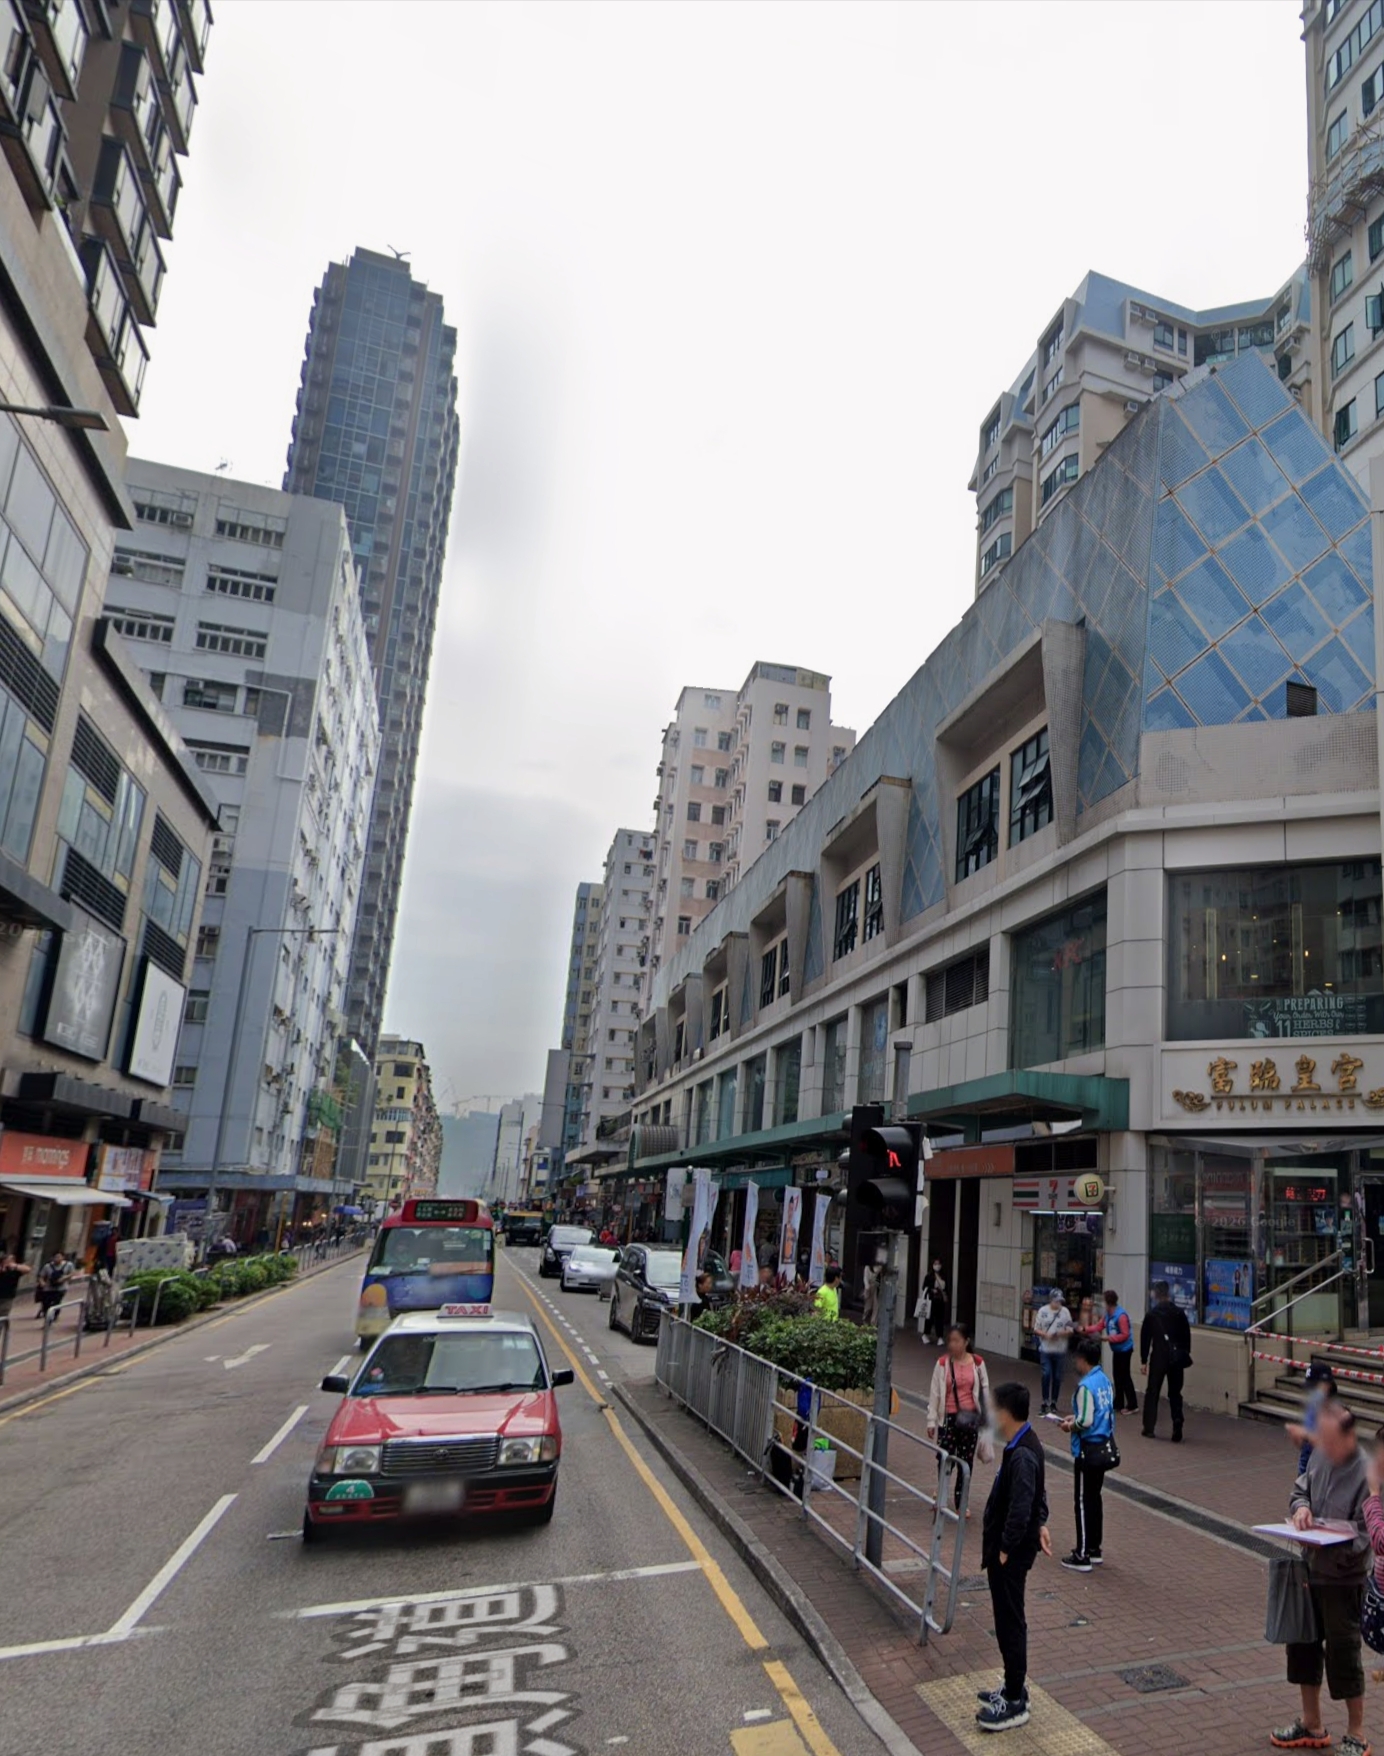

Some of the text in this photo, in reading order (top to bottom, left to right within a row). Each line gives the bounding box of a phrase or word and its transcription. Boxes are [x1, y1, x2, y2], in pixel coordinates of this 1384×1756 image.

[1284, 996, 1344, 1011] PREPARING
[1293, 1019, 1334, 1029] HERBS
[1207, 1052, 1364, 1094] 富臨皇宮
[1284, 1098, 1355, 1110] PALACE
[445, 1305, 489, 1315] TAXI
